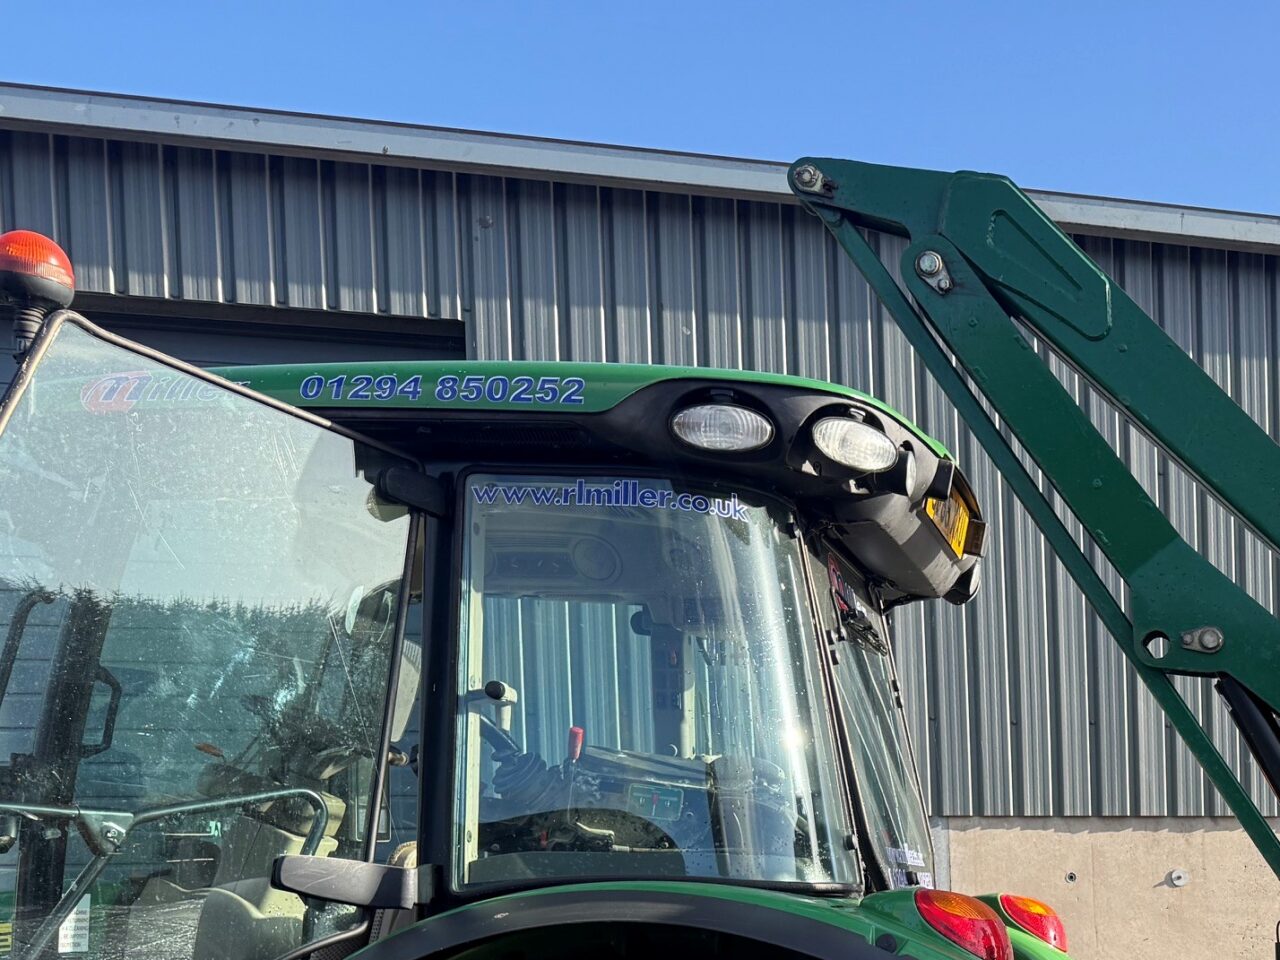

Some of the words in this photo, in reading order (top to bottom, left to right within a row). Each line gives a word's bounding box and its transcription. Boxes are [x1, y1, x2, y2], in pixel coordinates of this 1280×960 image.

[300, 375, 422, 401] 01294
[435, 376, 586, 405] 850252
[471, 479, 749, 522] www.rlmiller.co.uk
